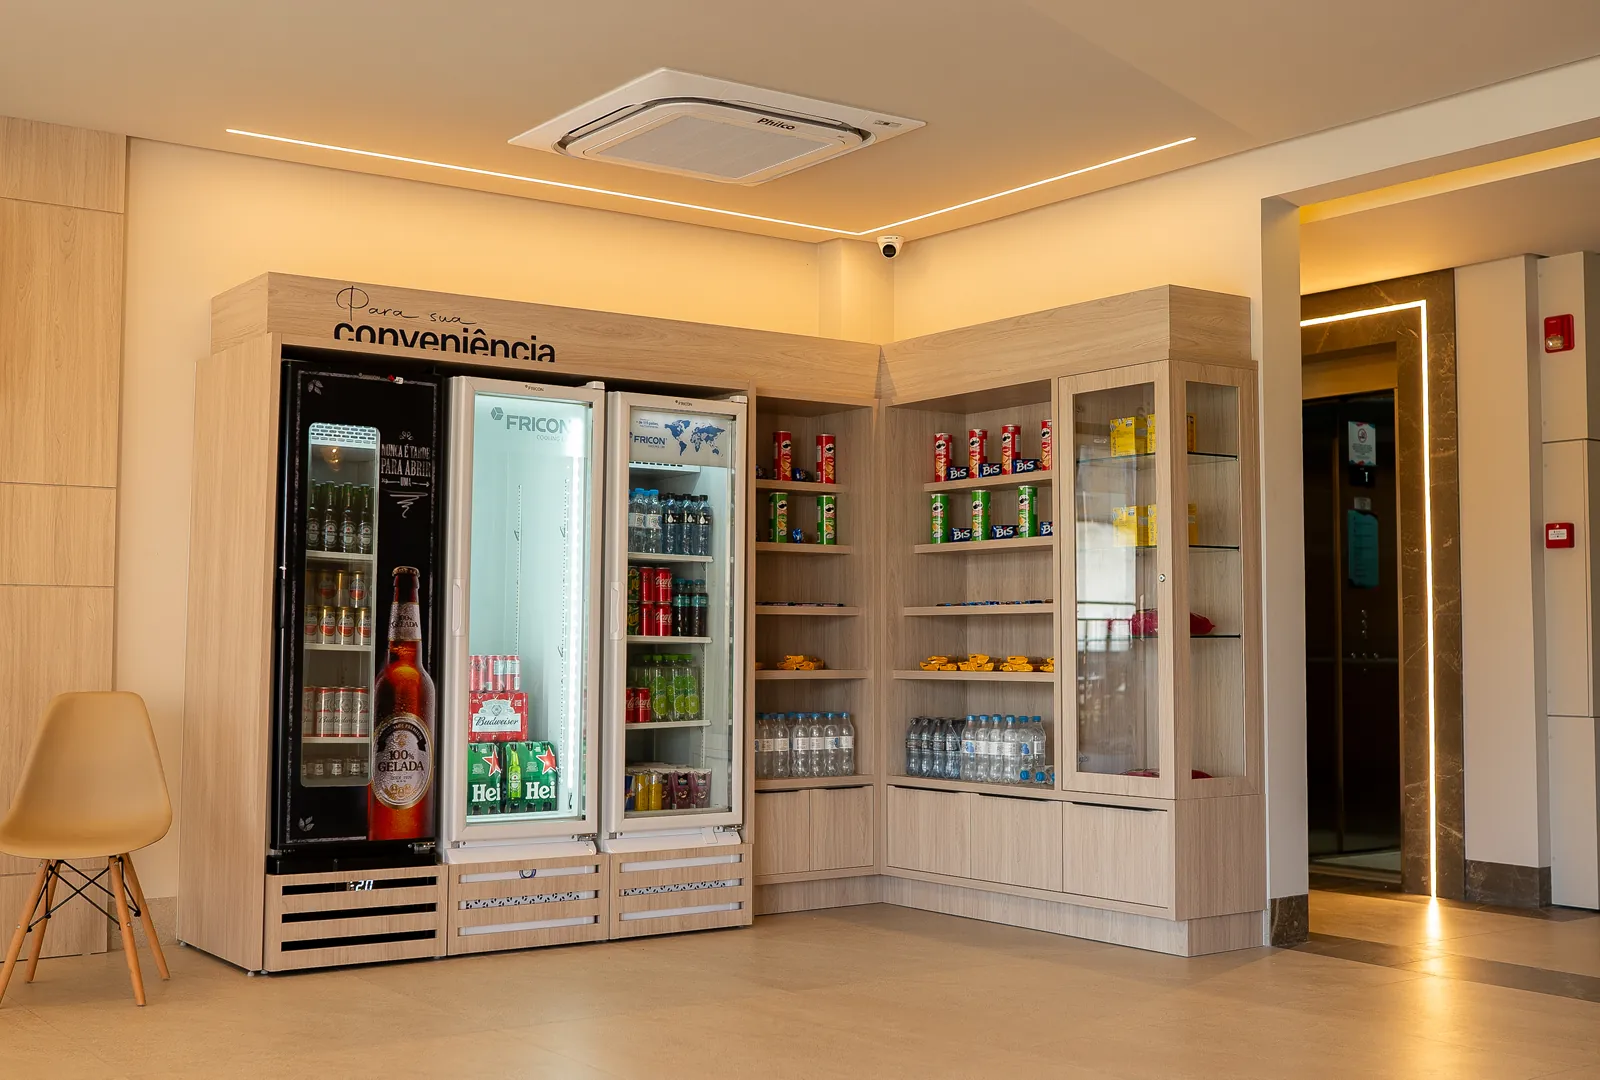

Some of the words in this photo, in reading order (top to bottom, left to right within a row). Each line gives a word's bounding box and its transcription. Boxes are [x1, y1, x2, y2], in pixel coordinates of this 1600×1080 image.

[757, 117, 796, 131] Philco
[336, 285, 419, 321] Para
[429, 312, 477, 325] sua
[333, 322, 556, 363] conveniência
[633, 435, 666, 446] FRICON
[381, 443, 403, 458] NUNCA
[404, 443, 409, 458] É
[410, 445, 431, 460] TARDE
[381, 457, 403, 475] PARA
[404, 460, 431, 477] ABRIR
[475, 716, 519, 726] Budweiser
[389, 749, 415, 761] 100%
[378, 760, 424, 773] GELADA
[472, 783, 501, 802] Hei
[525, 781, 556, 800] Hei
